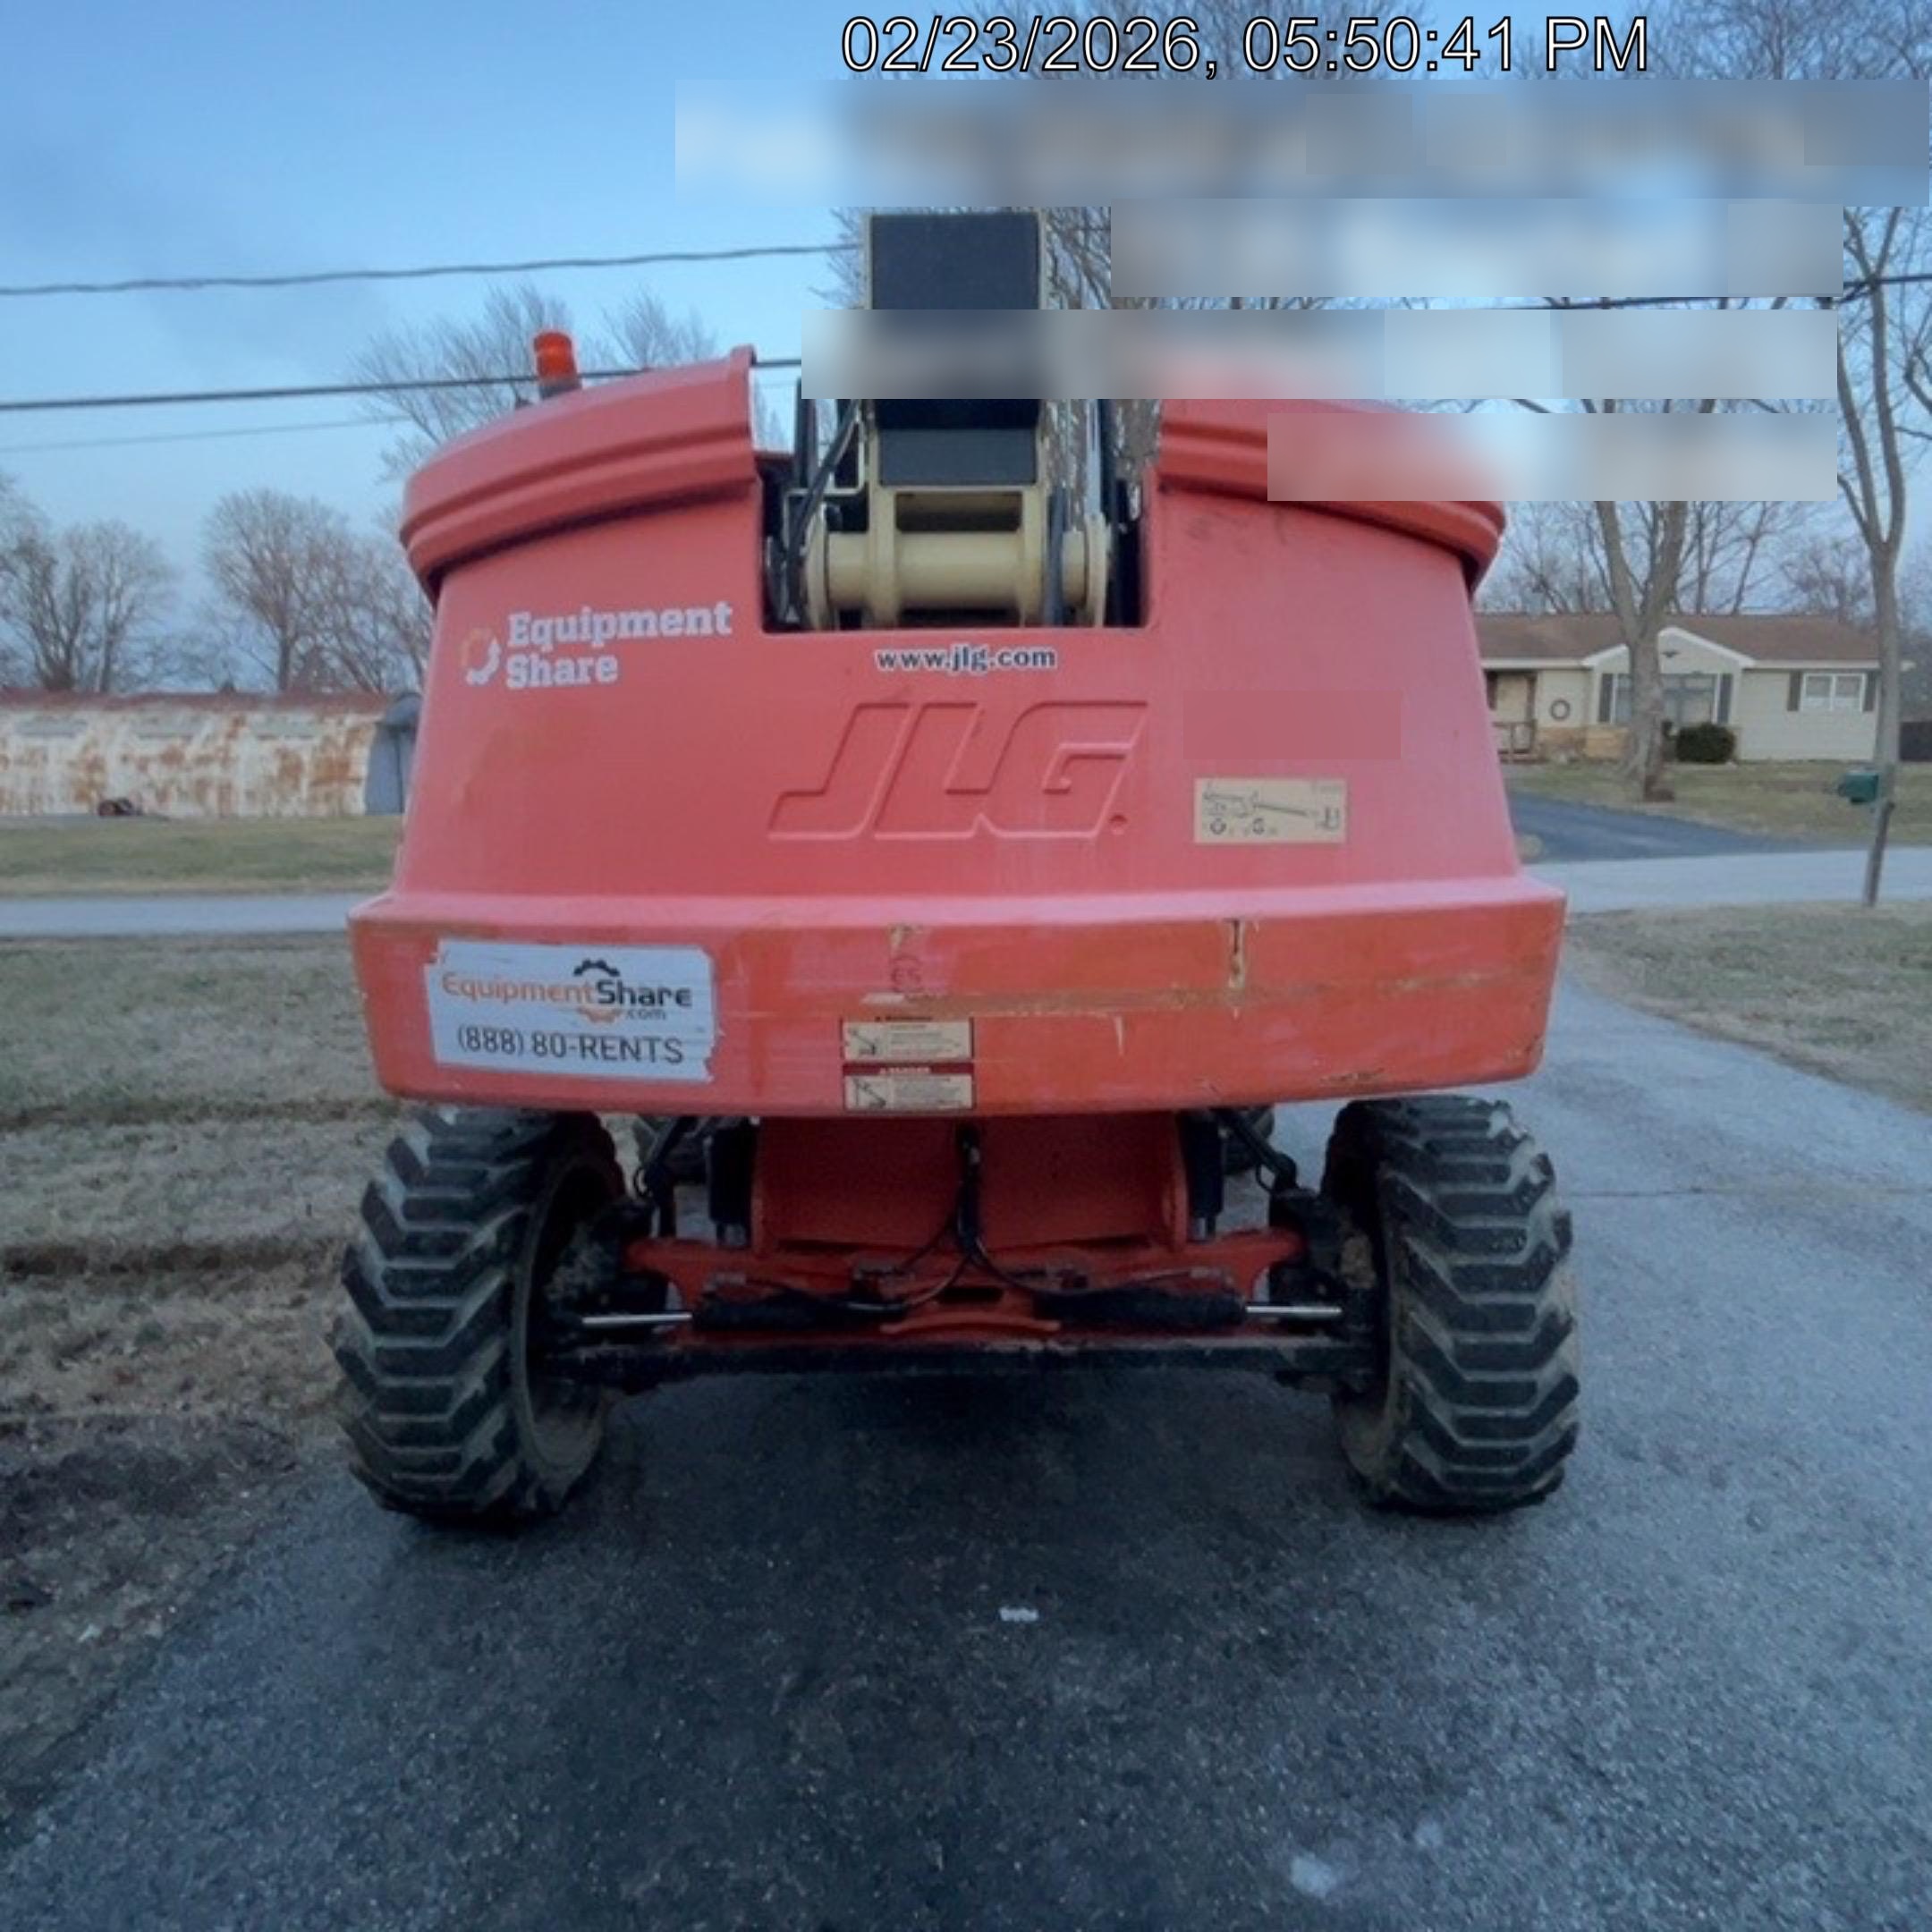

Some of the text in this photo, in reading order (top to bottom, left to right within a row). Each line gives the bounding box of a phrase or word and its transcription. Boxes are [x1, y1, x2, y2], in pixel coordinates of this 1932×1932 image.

[507, 601, 733, 651] Equipment
[505, 653, 619, 689] Share
[876, 644, 1057, 671] www.jlg.com
[767, 700, 1148, 839] JLG
[442, 971, 692, 1007] EquipmentShare
[457, 1026, 683, 1064] (888) 80-RENTS
